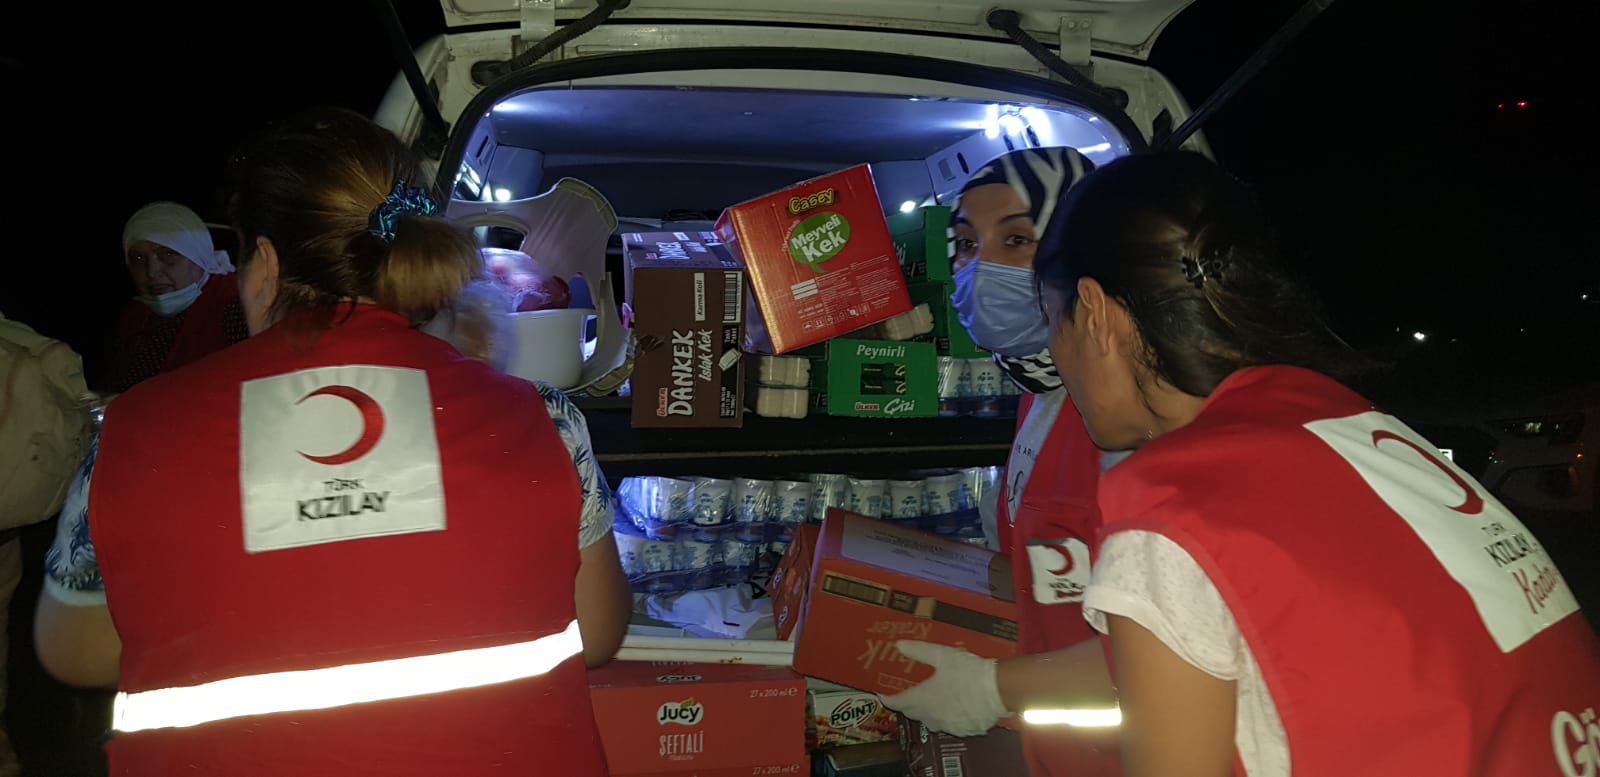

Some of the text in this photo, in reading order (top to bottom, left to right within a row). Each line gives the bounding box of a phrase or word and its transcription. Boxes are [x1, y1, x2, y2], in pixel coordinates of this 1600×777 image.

[789, 188, 834, 214] Casey
[791, 214, 841, 250] Meyveli
[802, 231, 847, 262] Kek
[697, 328, 713, 381] Islak Kek
[856, 344, 905, 359] Peynirli
[668, 329, 694, 416] DANKEK
[883, 398, 915, 415] Çizi
[296, 491, 392, 521] KIZILAY
[764, 688, 778, 697] 200
[660, 704, 700, 722] Jucy
[831, 701, 875, 725] POINT
[659, 730, 704, 757] ŞEFTALİ
